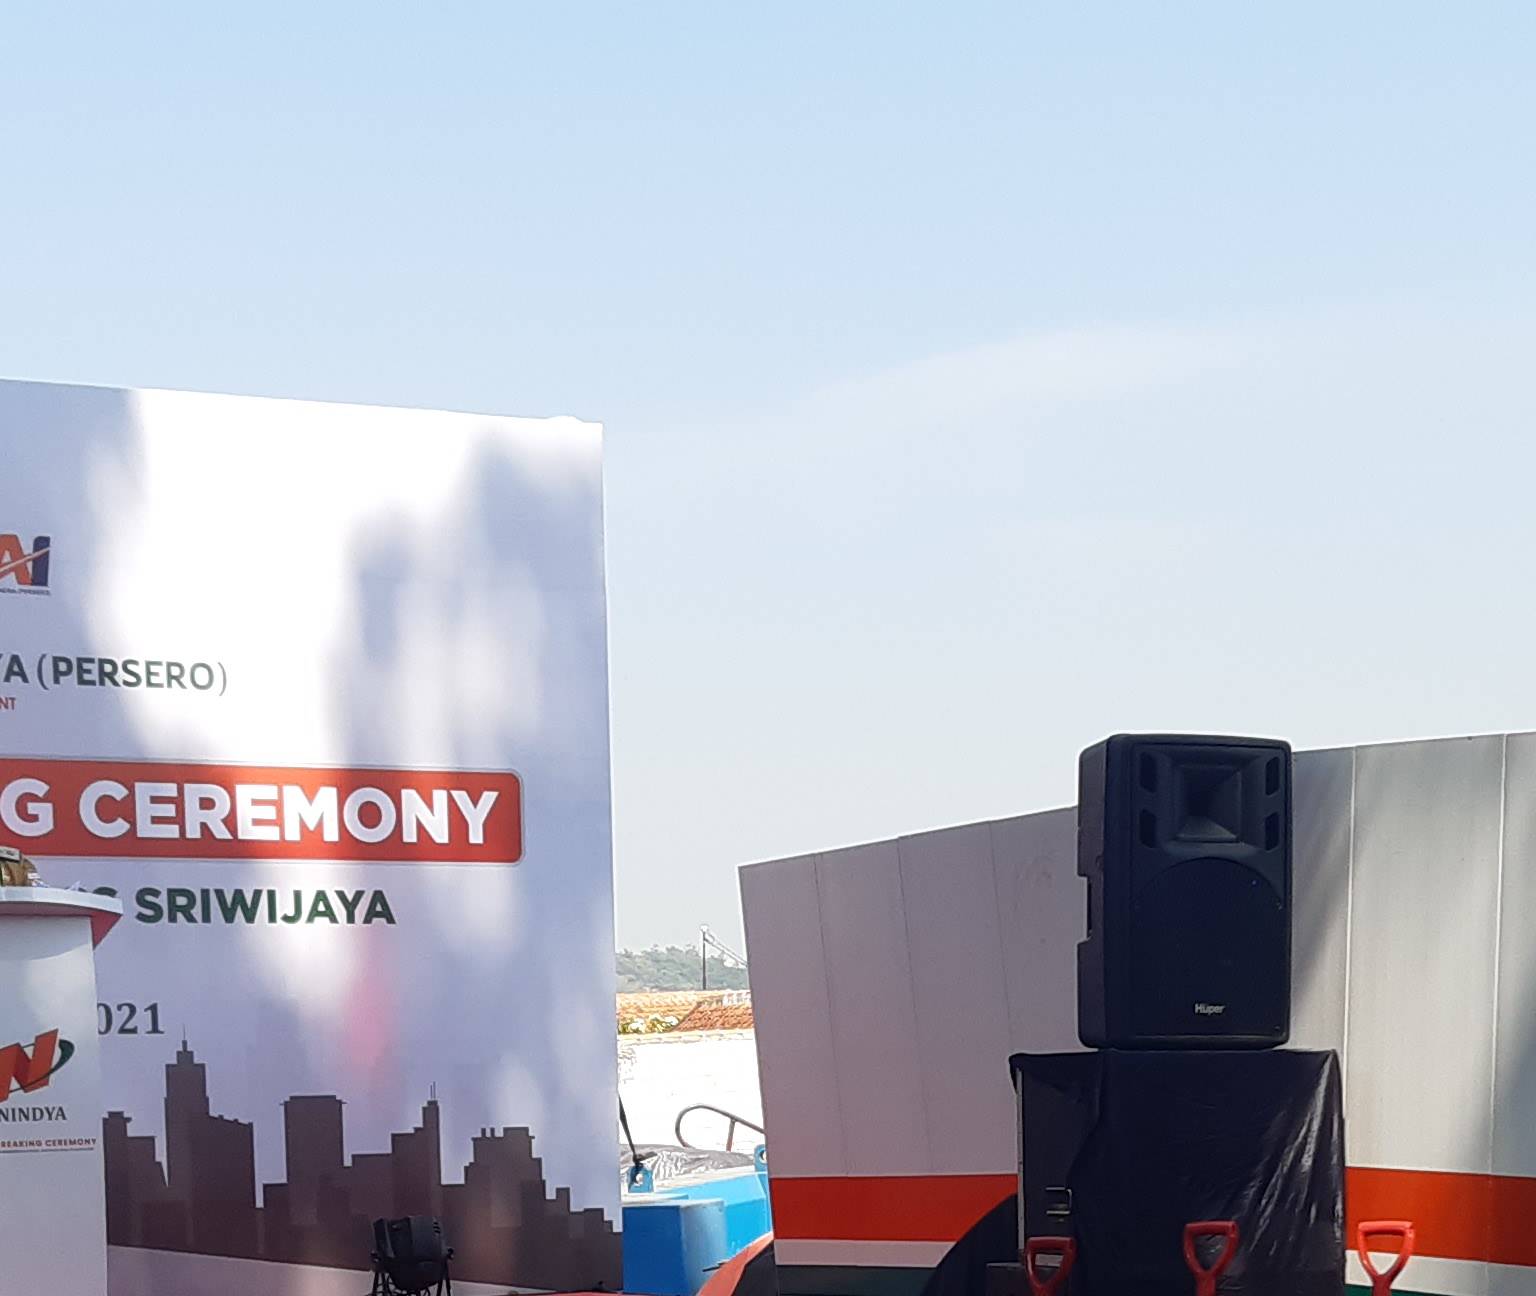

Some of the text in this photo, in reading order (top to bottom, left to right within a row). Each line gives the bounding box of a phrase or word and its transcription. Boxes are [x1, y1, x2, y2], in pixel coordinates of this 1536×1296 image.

[36, 653, 228, 696] (PERSERO)
[78, 781, 499, 845] CEREMONY
[134, 887, 396, 925] SRIWIJAYA
[97, 1002, 165, 1036] 021
[45, 1138, 96, 1147] CEREMONY
